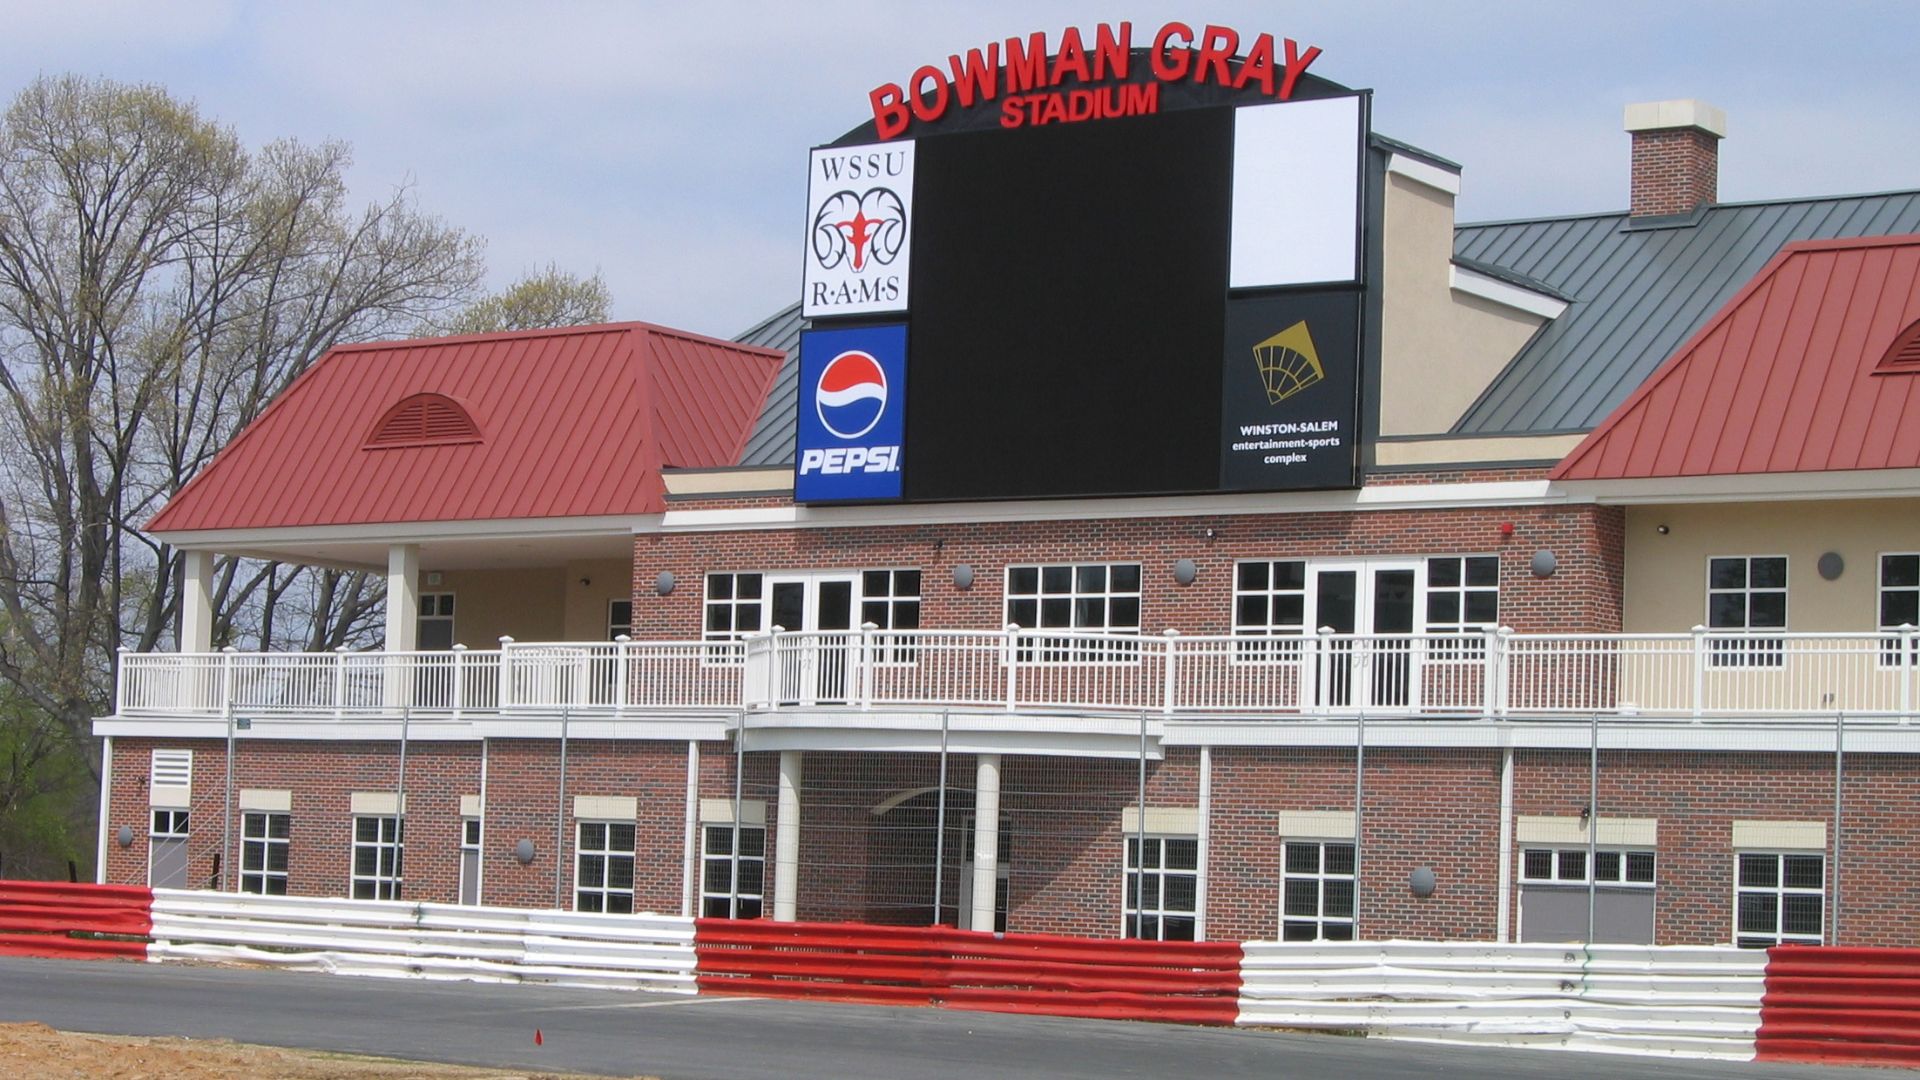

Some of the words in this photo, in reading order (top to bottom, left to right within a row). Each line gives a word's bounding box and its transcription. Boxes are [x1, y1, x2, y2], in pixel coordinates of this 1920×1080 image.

[868, 21, 1131, 140] BOWMAN
[1151, 21, 1322, 99] GRAY
[1000, 82, 1158, 128] STADIUM
[820, 151, 906, 182] WSSU
[1240, 421, 1338, 435] WINSTON-SALEM
[1232, 437, 1340, 451] entertainment-sports
[1264, 452, 1307, 465] complex
